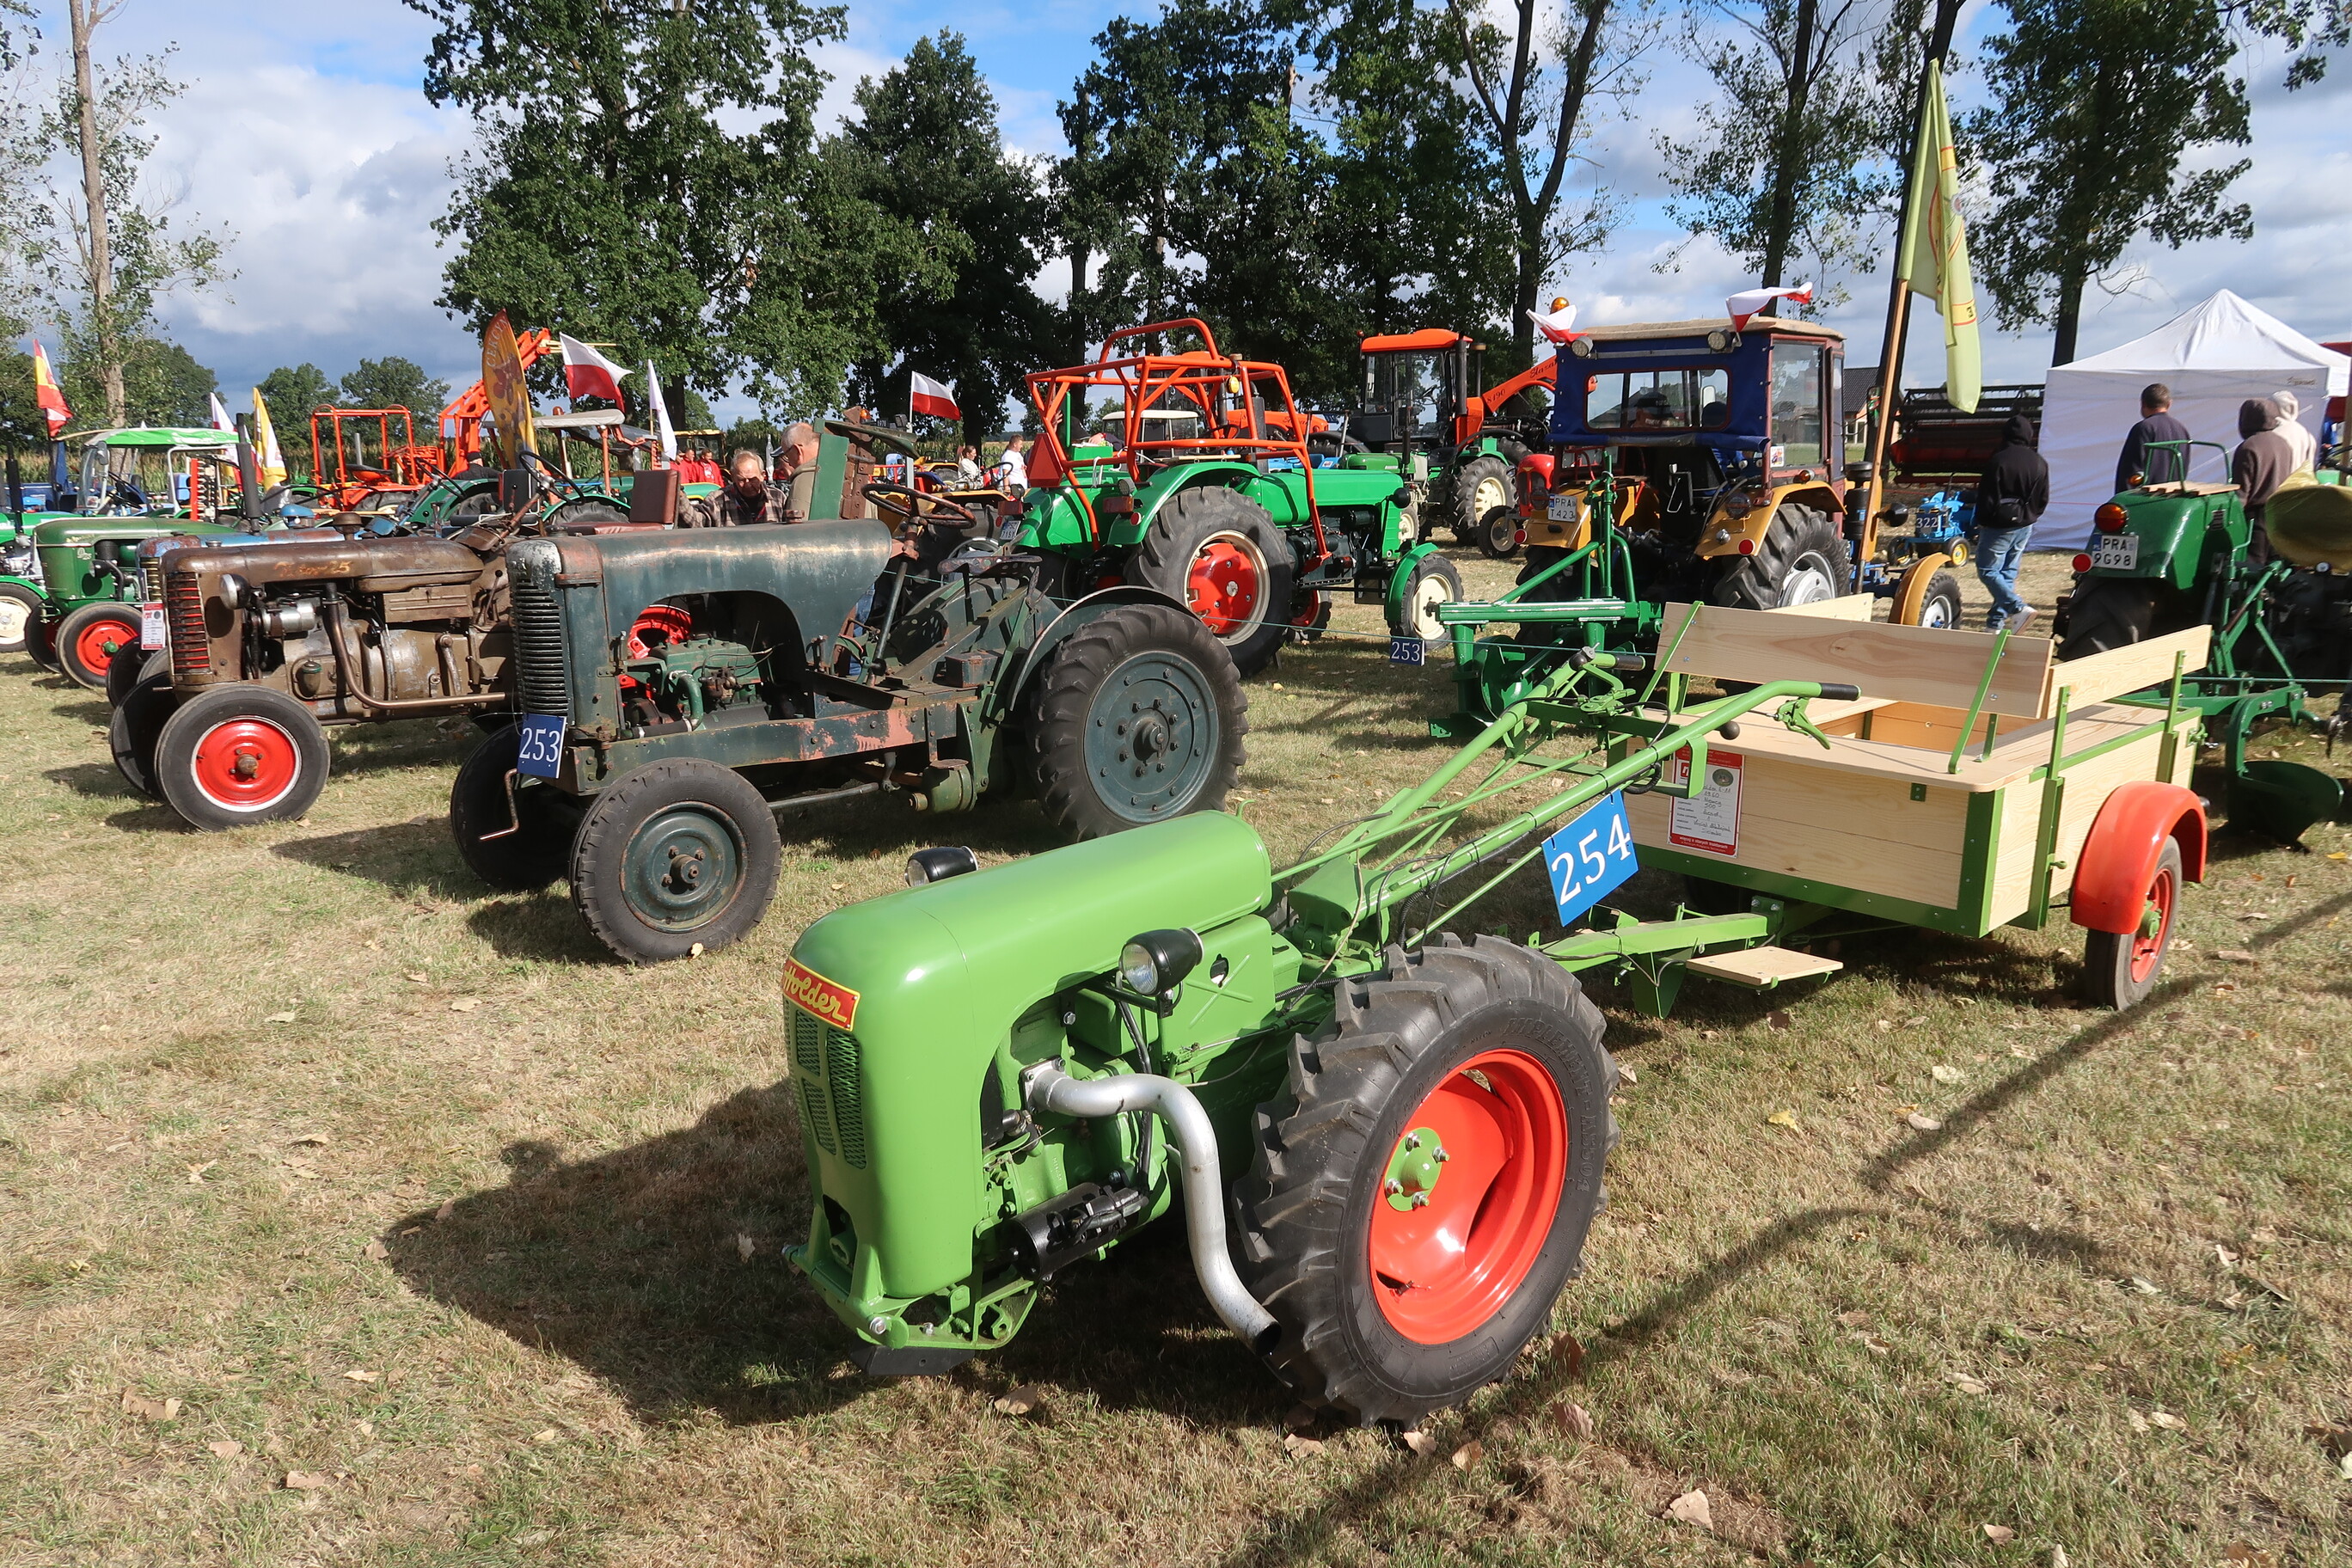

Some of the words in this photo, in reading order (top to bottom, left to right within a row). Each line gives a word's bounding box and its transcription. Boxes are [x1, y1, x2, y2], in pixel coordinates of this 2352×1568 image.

[1555, 498, 1571, 508] PRA
[1916, 517, 1939, 529] 322
[2103, 538, 2128, 551] PRA
[2094, 552, 2131, 567] 9G98
[1391, 641, 1420, 662] 253
[519, 727, 560, 763] 253
[1551, 813, 1632, 905] 254
[782, 965, 848, 1024] Holder
